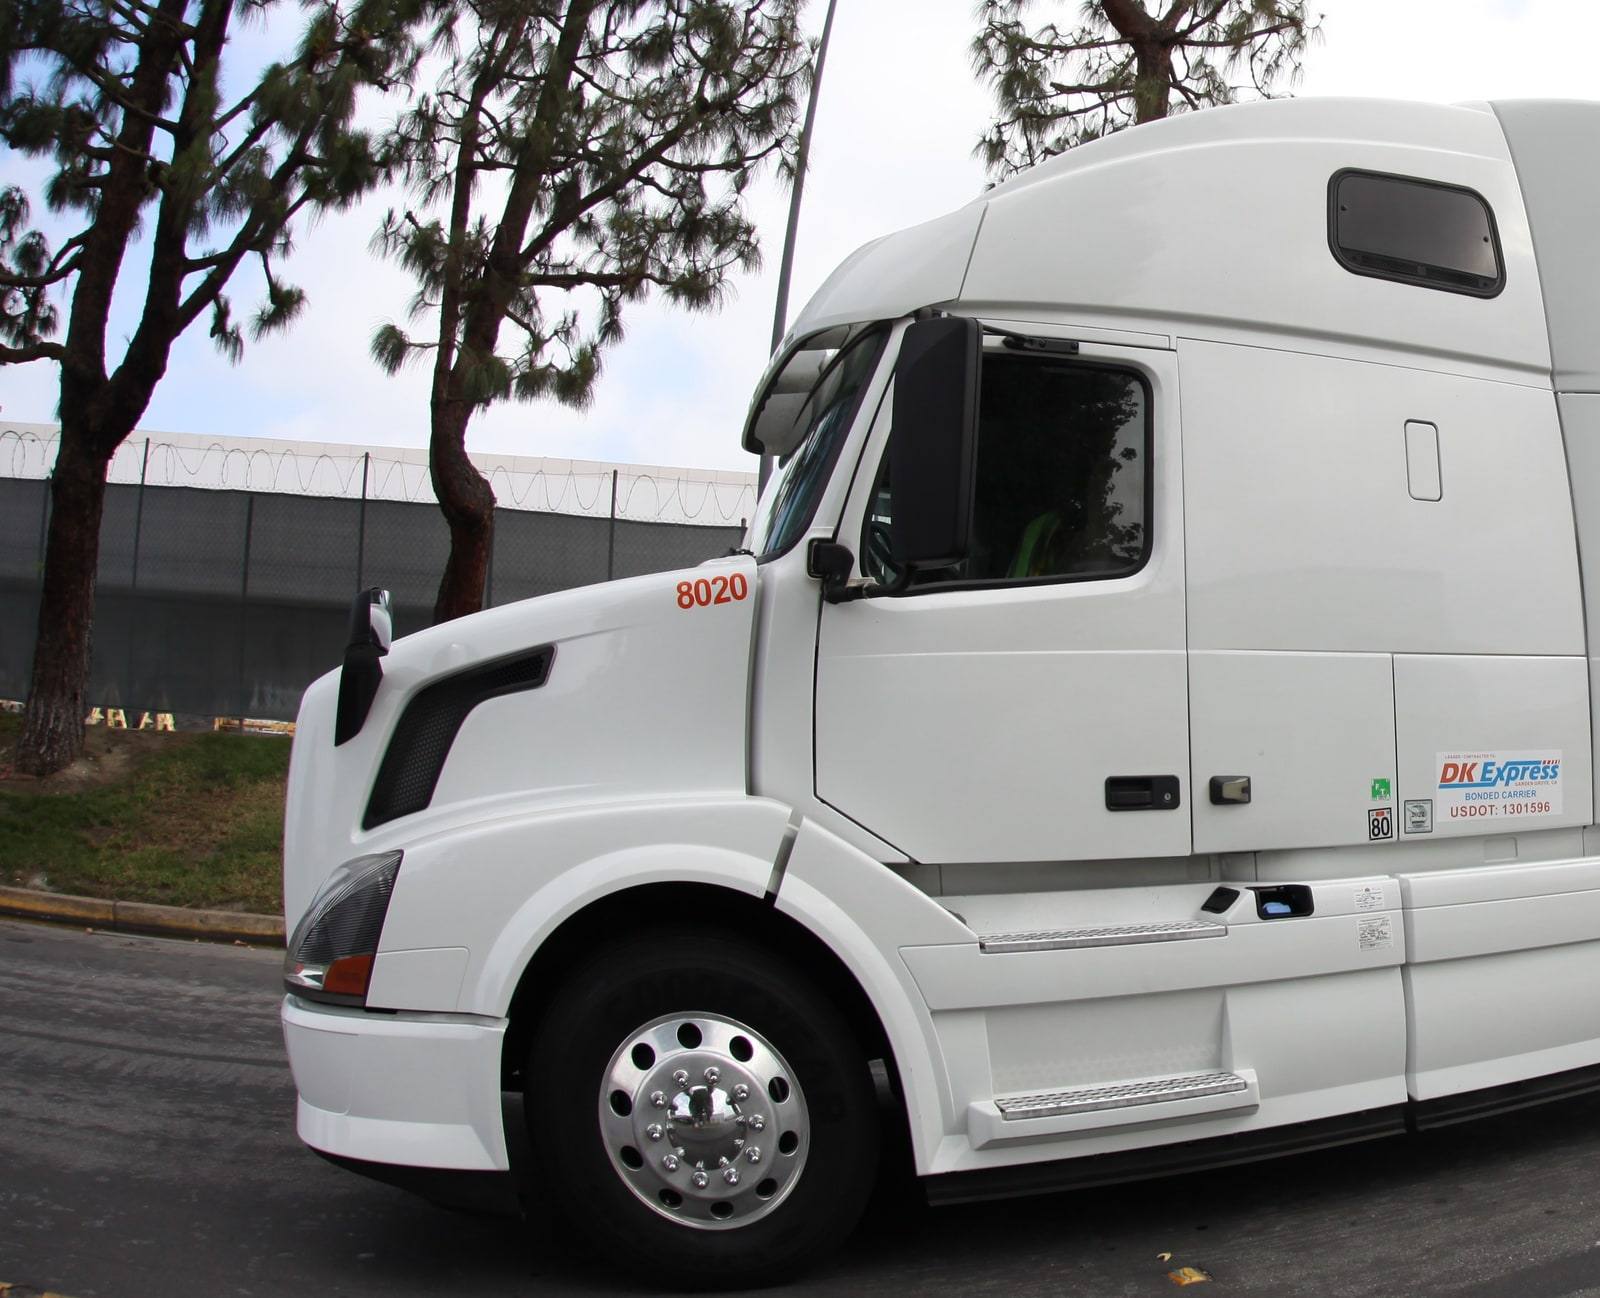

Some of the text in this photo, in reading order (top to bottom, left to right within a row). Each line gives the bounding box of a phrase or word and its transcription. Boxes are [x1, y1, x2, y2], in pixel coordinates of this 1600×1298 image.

[677, 573, 748, 609] 8020
[1440, 760, 1559, 787] DK Express
[1465, 789, 1537, 801] BONDED CARRIER
[1450, 801, 1551, 818] USDOT: 1301596
[1371, 816, 1390, 837] 80
